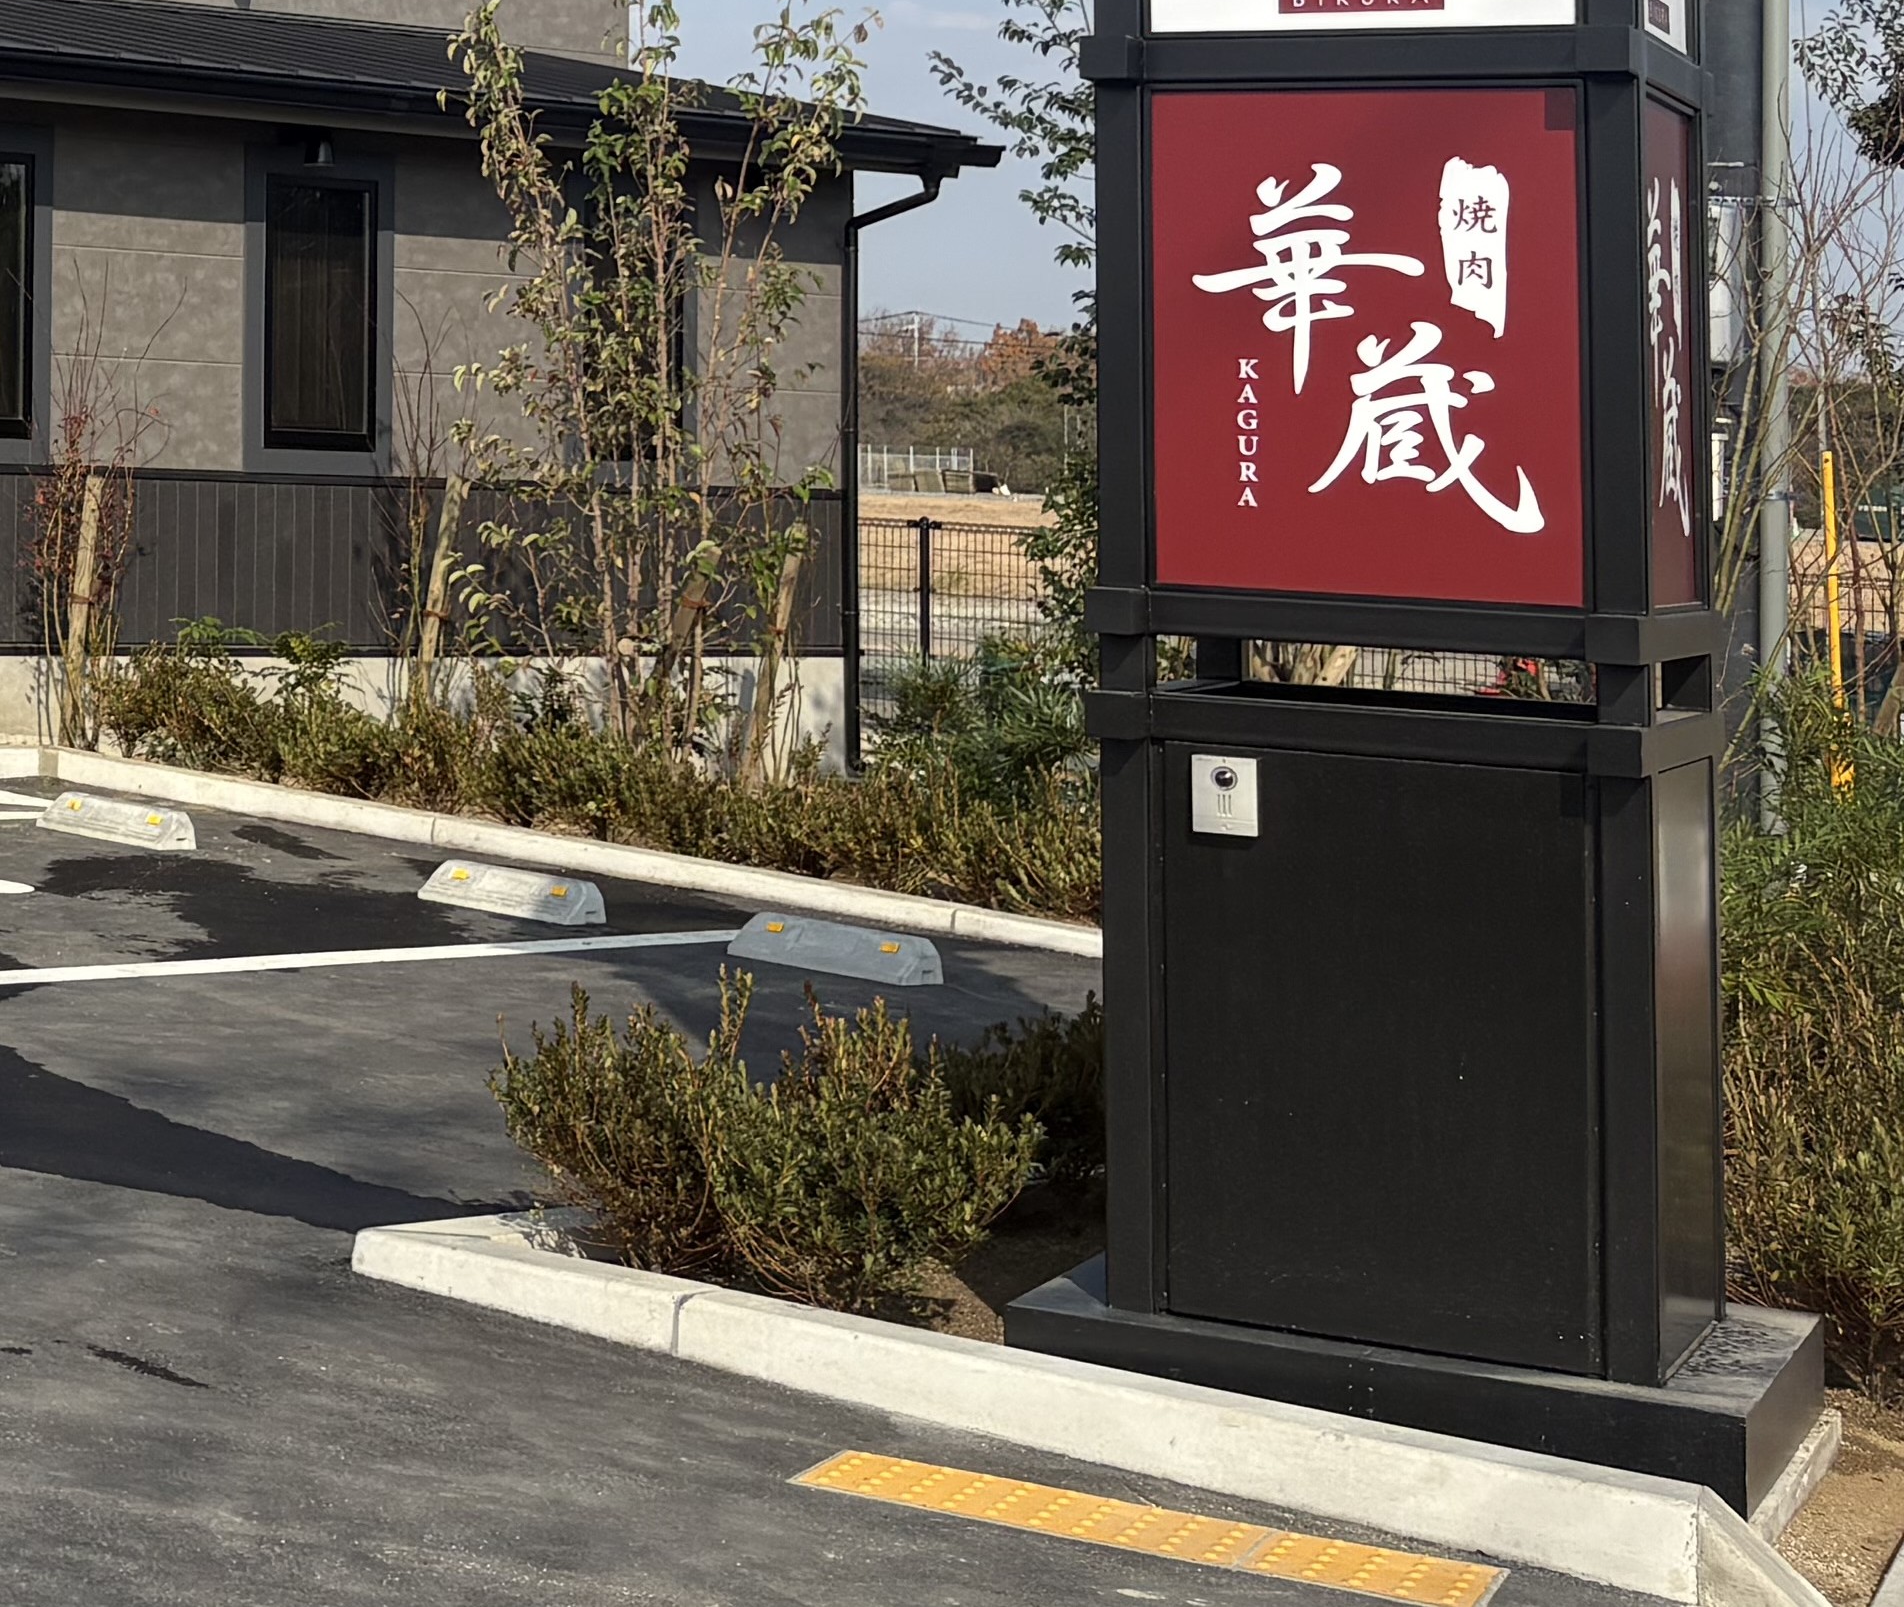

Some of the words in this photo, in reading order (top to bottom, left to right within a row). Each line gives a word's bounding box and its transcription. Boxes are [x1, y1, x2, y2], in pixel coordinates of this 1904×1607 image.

[1451, 194, 1498, 290] 焼肉
[1192, 162, 1545, 534] 華蔵
[1237, 358, 1259, 508] KAGURA
